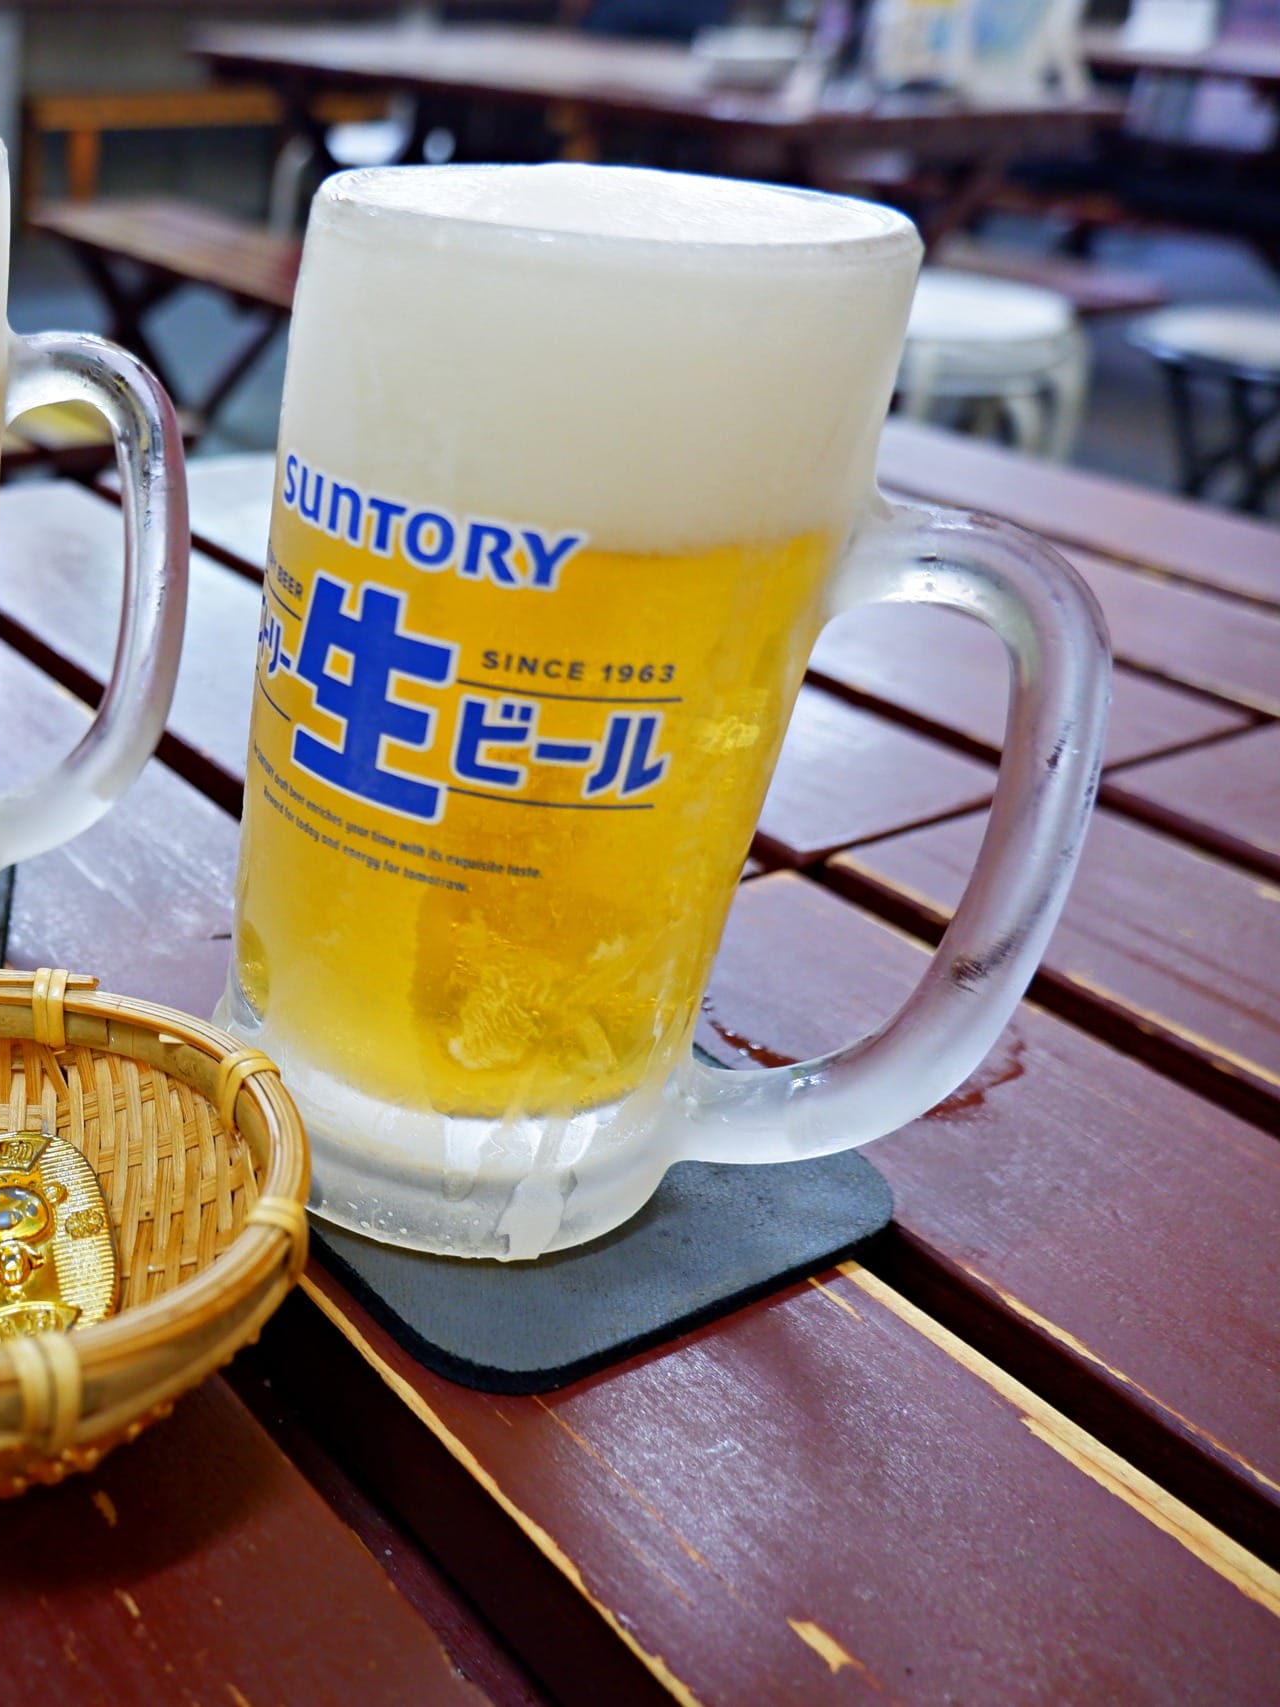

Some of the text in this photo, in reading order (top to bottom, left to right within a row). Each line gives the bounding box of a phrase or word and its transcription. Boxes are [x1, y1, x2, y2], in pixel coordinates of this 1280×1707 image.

[282, 452, 583, 588] SUNTORY
[482, 650, 676, 684] SINCE 1963
[345, 822, 369, 838] your
[371, 831, 396, 848] time
